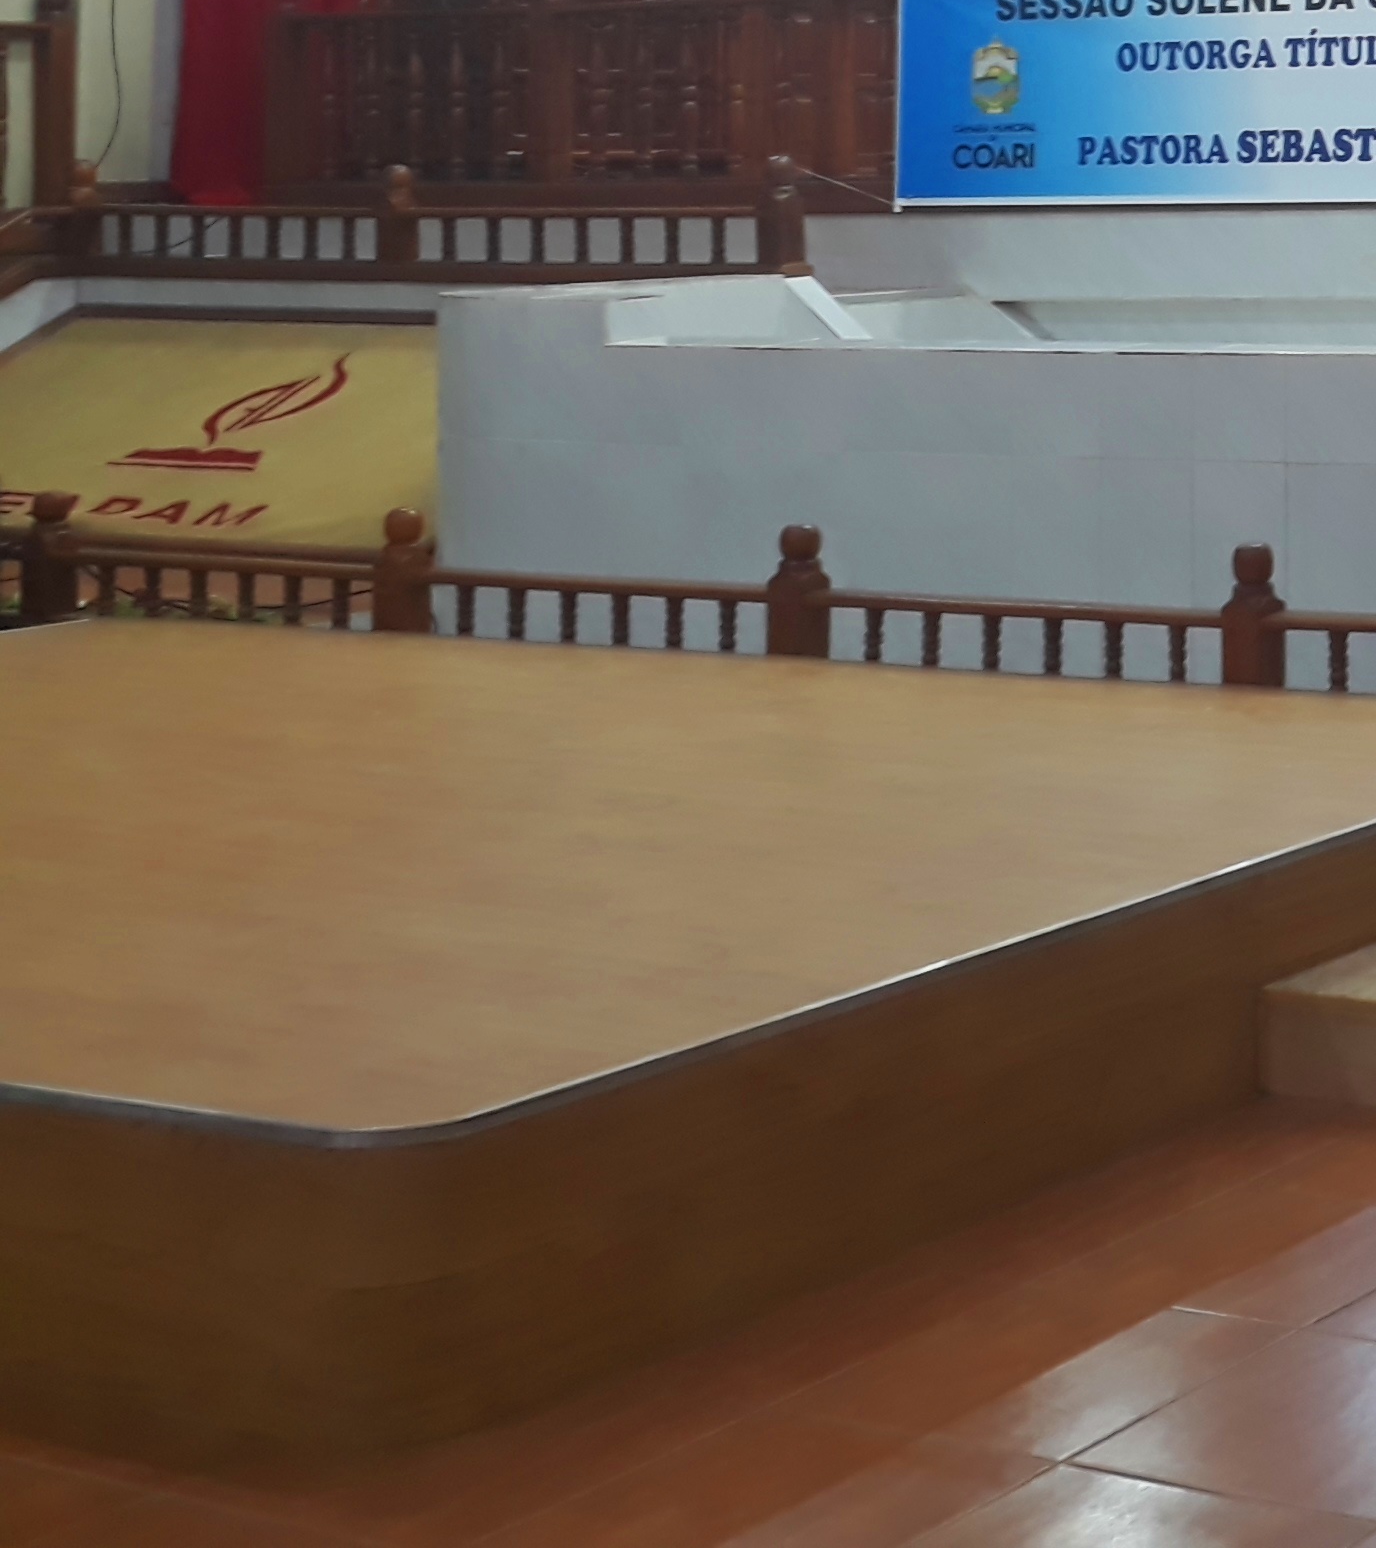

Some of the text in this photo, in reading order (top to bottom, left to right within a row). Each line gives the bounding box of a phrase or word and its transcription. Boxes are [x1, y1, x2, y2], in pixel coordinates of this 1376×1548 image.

[1116, 36, 1276, 72] OUTORGA
[953, 143, 1036, 169] COARI
[1077, 132, 1229, 167] PASTORA
